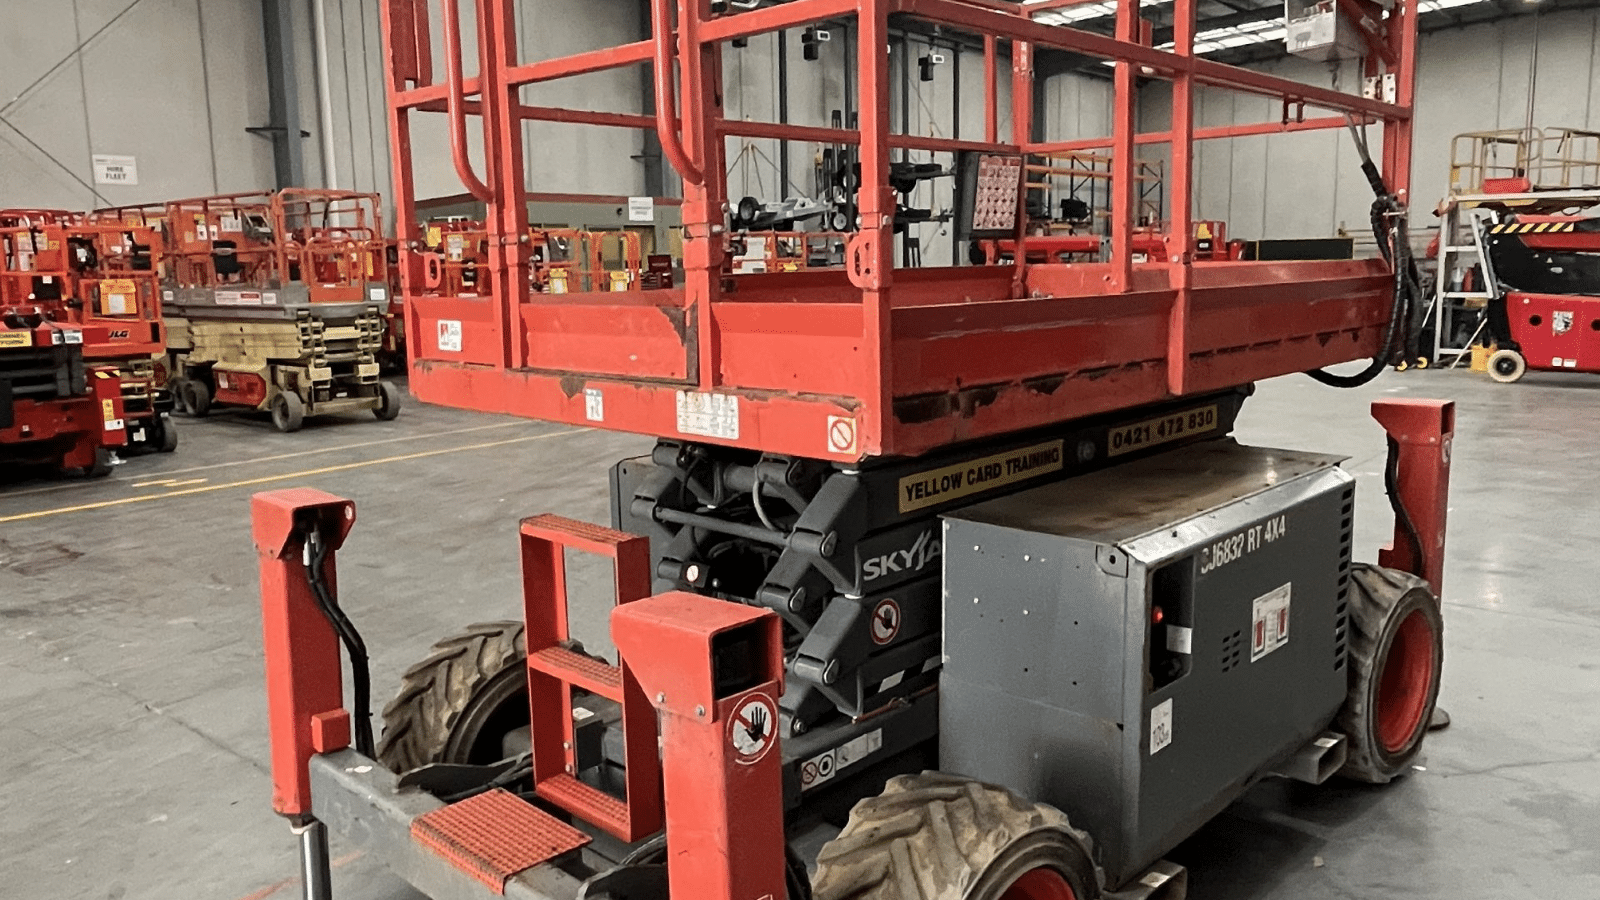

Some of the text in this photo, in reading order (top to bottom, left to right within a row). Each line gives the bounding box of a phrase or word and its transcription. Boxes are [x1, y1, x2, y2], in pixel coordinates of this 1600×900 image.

[110, 330, 129, 338] JLG
[1112, 409, 1213, 449] 0421 472 830
[905, 446, 1060, 501] YELLOW CARD TRAINING
[1247, 525, 1263, 553] RT
[1264, 514, 1286, 543] 4X4
